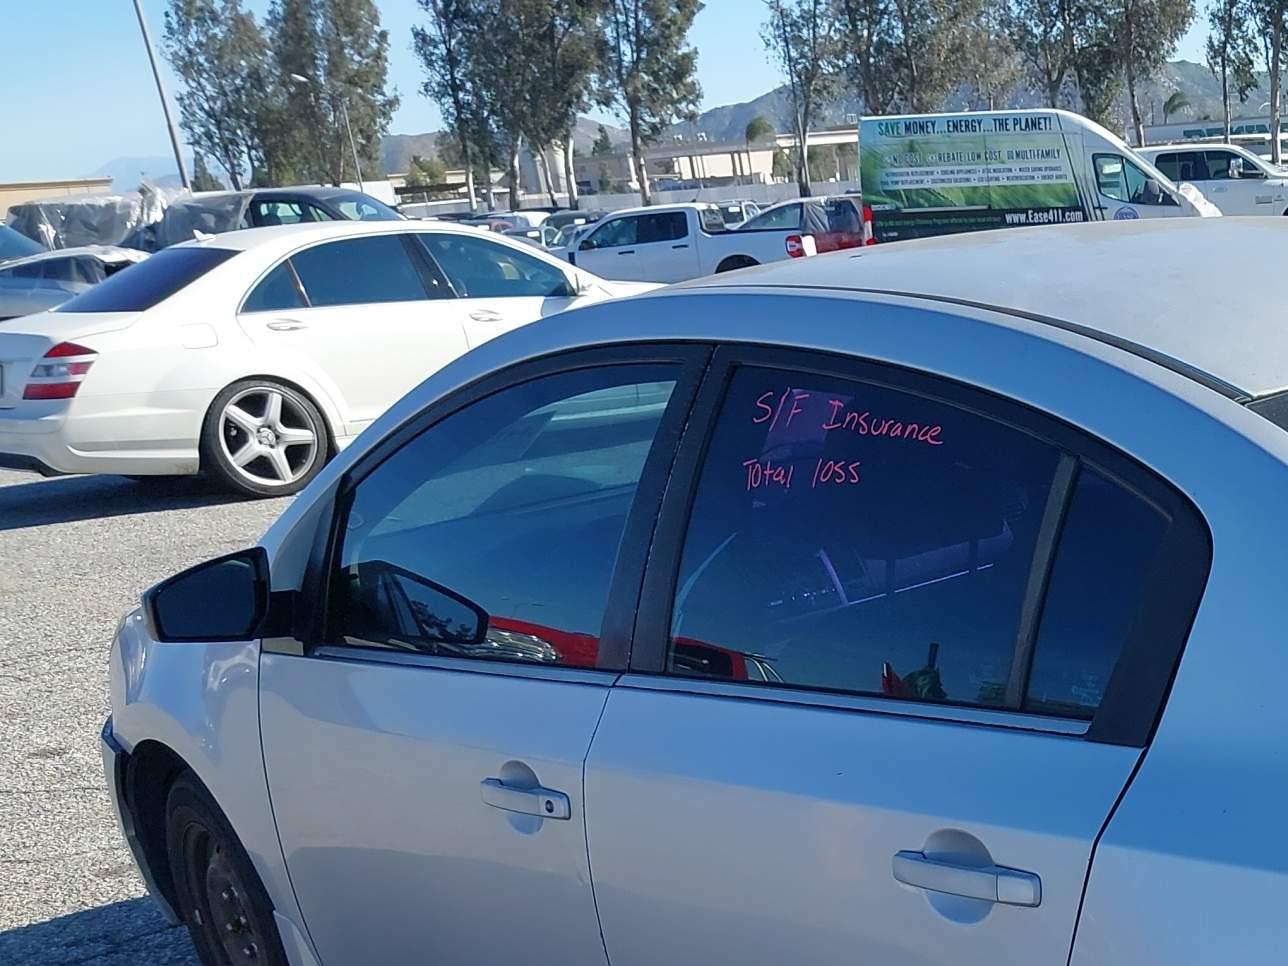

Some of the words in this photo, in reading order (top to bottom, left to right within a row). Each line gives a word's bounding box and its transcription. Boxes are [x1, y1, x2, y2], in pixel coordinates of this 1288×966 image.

[877, 120, 902, 136] SAVE
[1012, 116, 1053, 132] PLANET!
[1005, 208, 1084, 225] www.Ease411.com
[753, 387, 810, 432] S/F
[822, 399, 943, 445] Insurance
[743, 458, 794, 491] Total
[812, 457, 861, 488] loss
